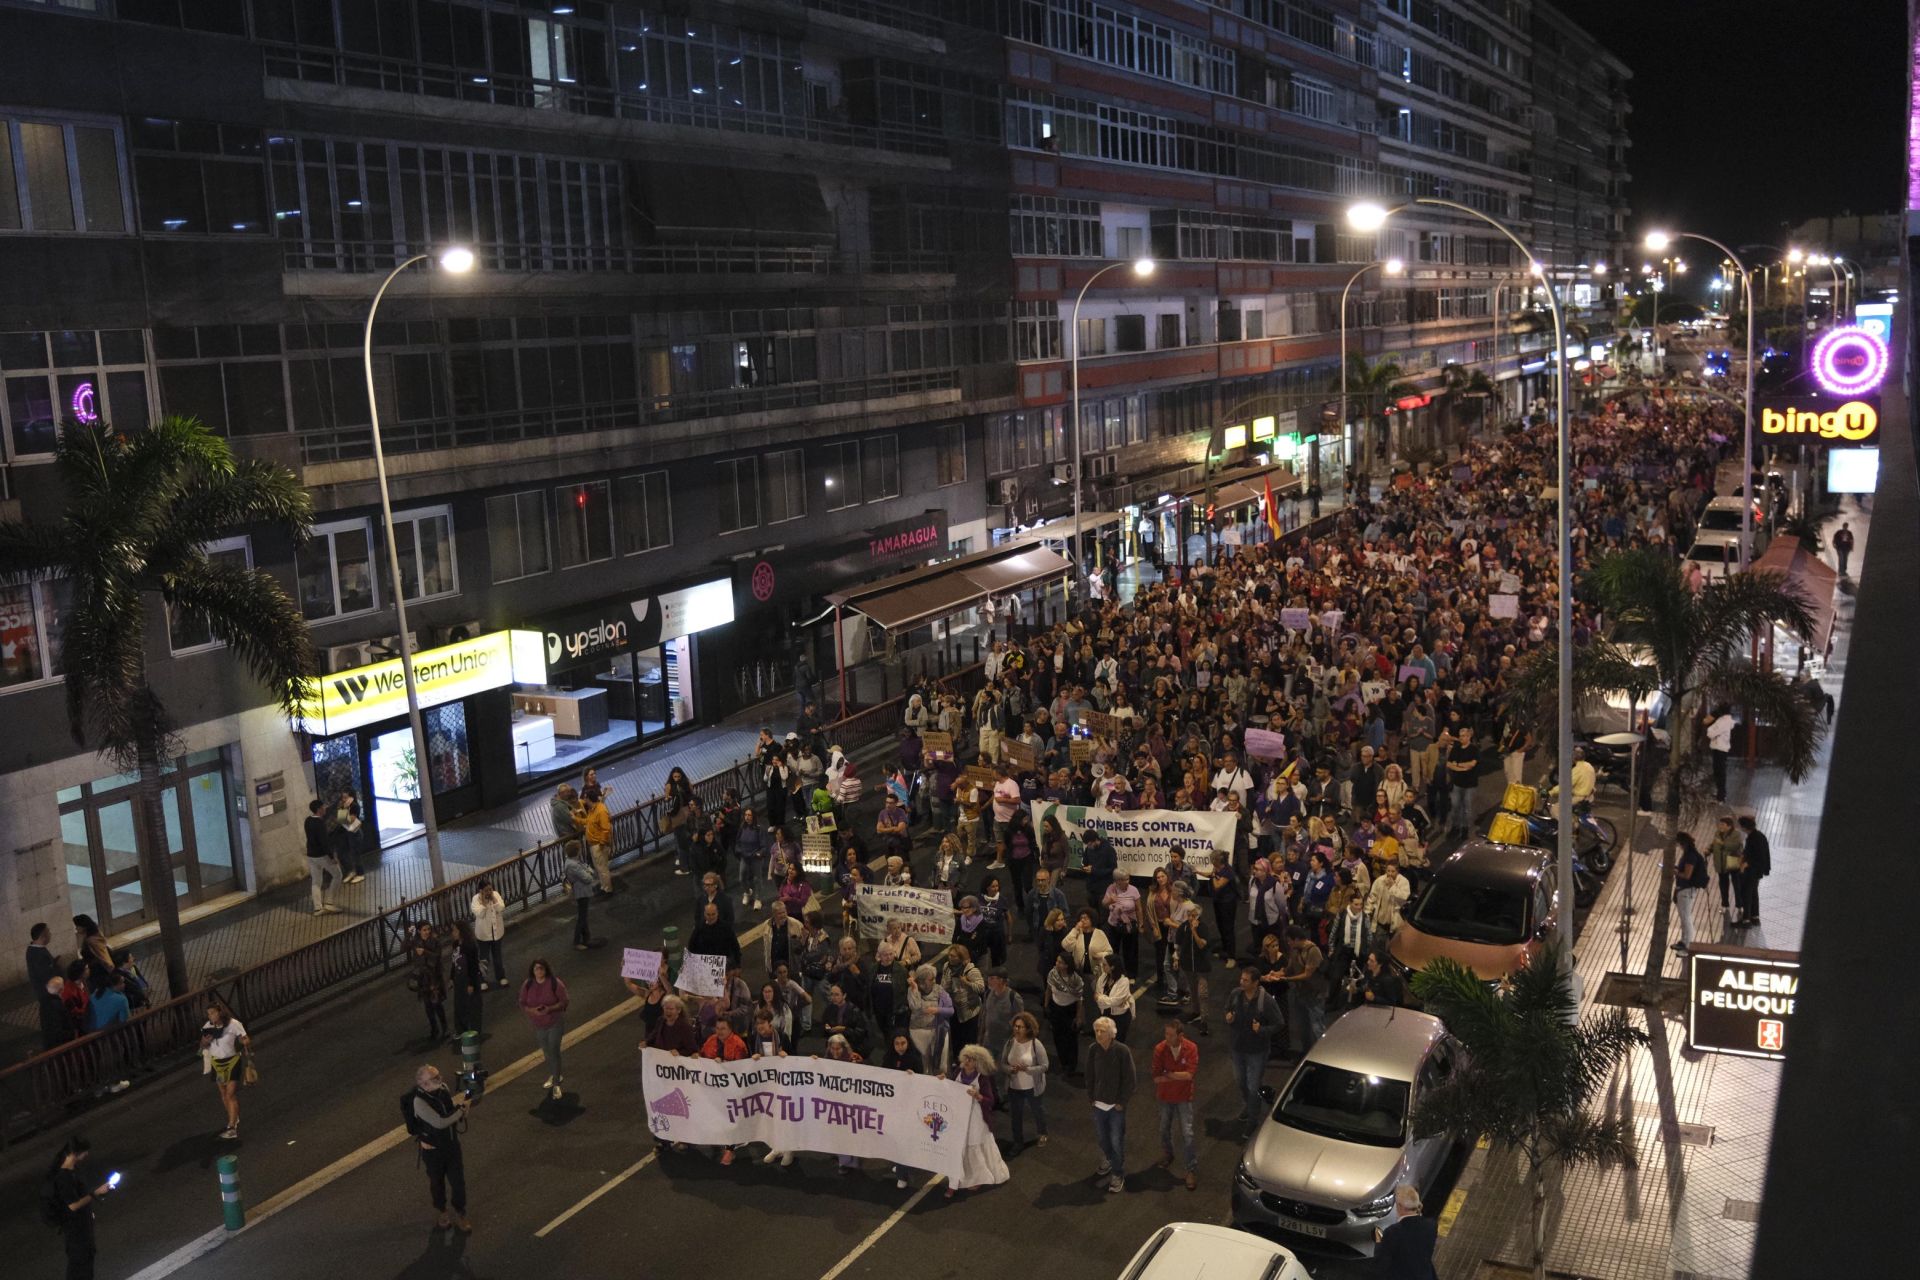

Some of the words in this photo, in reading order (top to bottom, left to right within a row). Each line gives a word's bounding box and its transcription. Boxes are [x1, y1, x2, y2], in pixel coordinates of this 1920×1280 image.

[869, 525, 938, 556] TAMARAGUA
[566, 619, 627, 659] ypsilon
[375, 661, 448, 694] Wetern
[1078, 819, 1139, 832] HOMBRES
[1142, 822, 1196, 833] CONTRA
[1149, 837, 1214, 850] MACHISTA
[877, 889, 921, 900] CUERPOS
[893, 904, 935, 916] PUEBLOS
[656, 1064, 701, 1084] CONTRA
[704, 1072, 730, 1088] LAS
[731, 1069, 815, 1089] VIOLENCIAS
[817, 1073, 895, 1098] MACHISTAS
[777, 1095, 805, 1122] TU
[811, 1097, 885, 1135] PARTE!
[923, 1100, 948, 1113] RED
